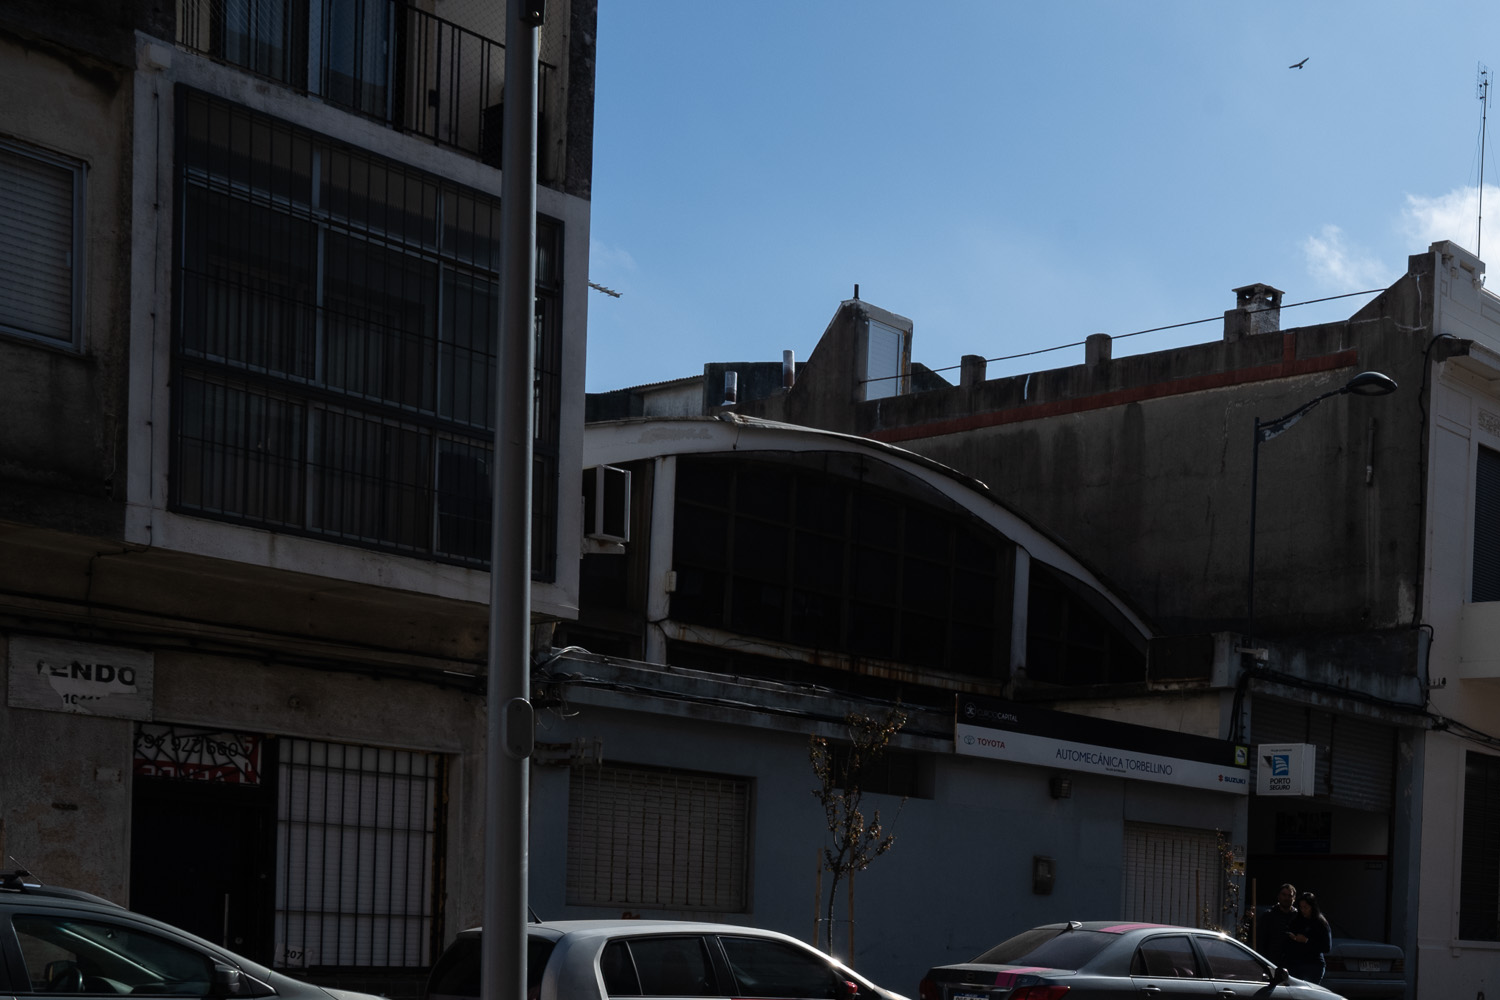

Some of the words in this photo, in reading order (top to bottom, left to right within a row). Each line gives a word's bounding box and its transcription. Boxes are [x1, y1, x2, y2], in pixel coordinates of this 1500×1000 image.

[36, 660, 136, 686] ENDO
[977, 737, 1006, 749] TOYOTA
[1055, 748, 1124, 769] AUTOMECÁNICA
[1125, 758, 1173, 776] TORBELLINO
[1224, 776, 1246, 785] SUZUKI
[1269, 777, 1291, 785] PORTO
